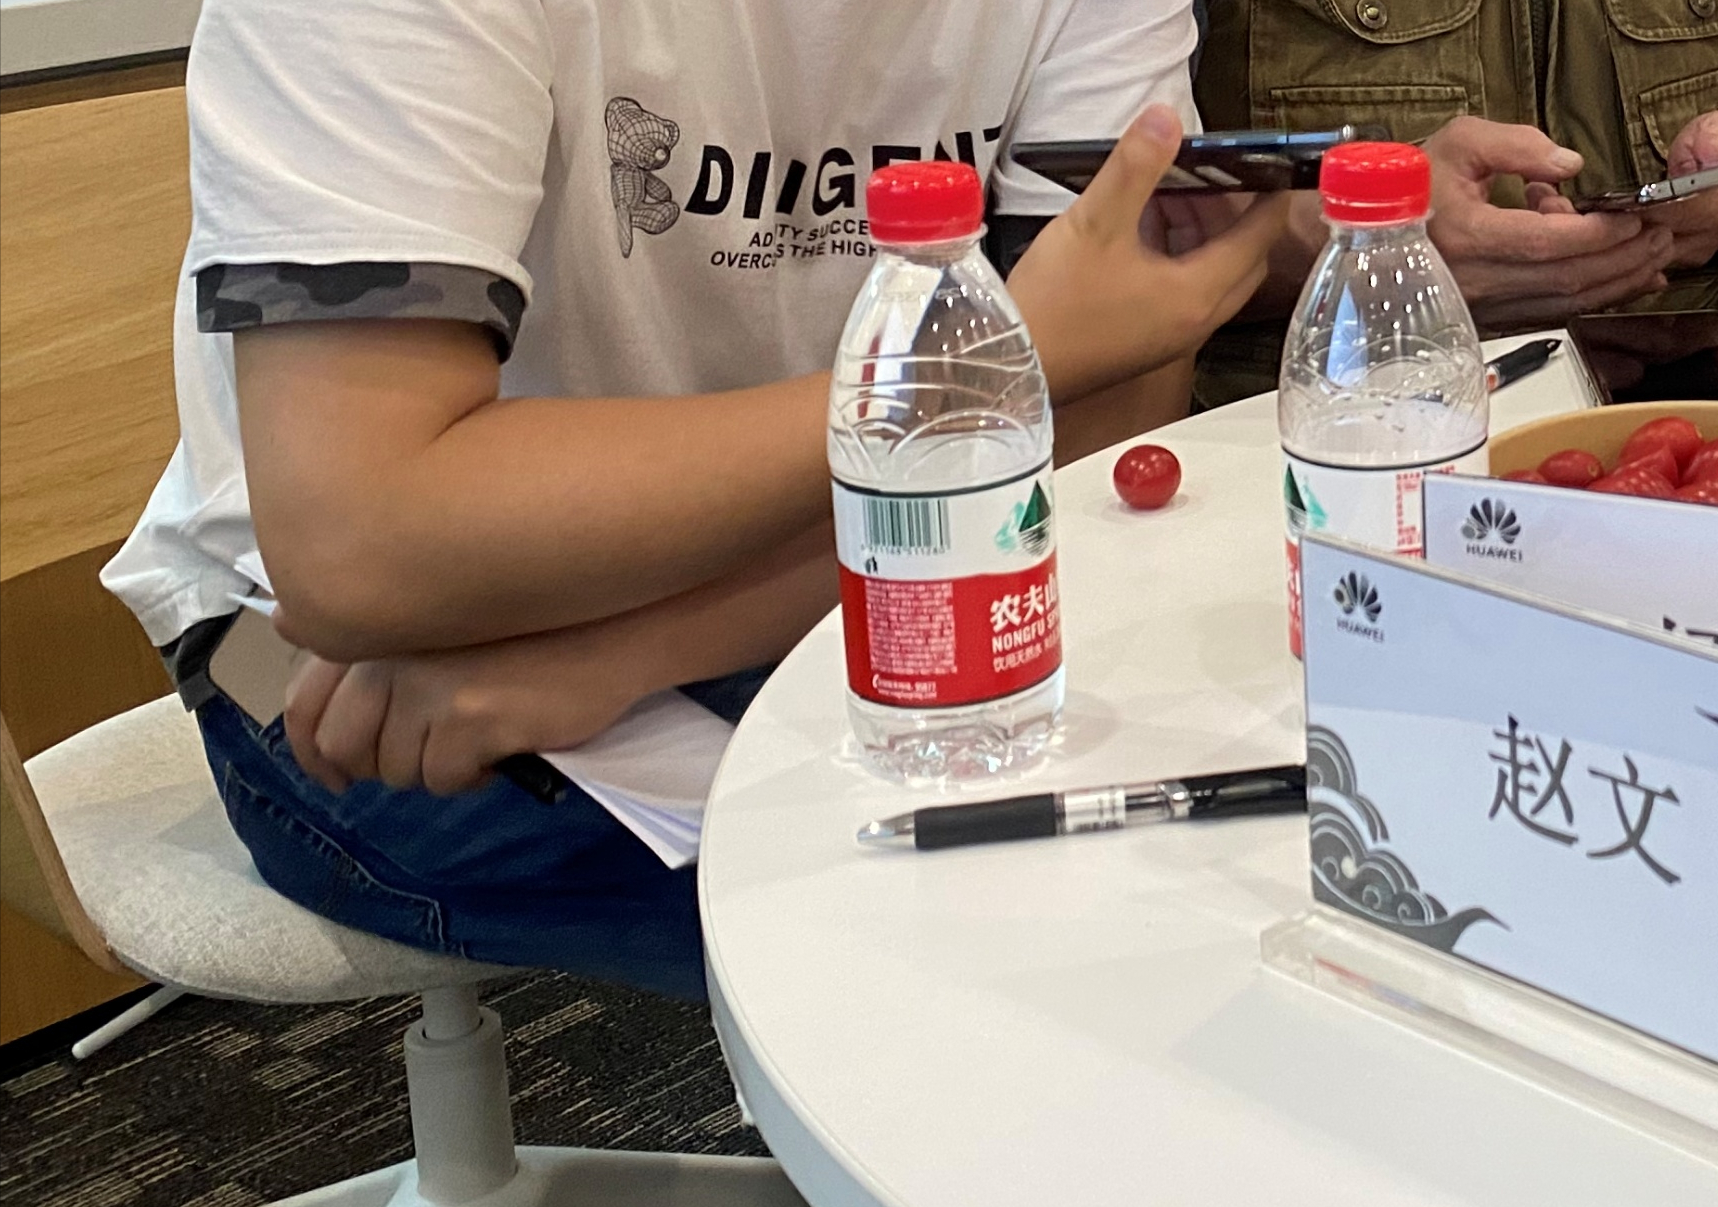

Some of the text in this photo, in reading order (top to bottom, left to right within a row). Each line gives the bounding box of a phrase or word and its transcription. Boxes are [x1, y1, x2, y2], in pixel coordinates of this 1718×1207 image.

[1466, 544, 1523, 561] HUAWEI
[992, 617, 1045, 654] NONGFU
[1336, 618, 1385, 643] HUAWEI
[1488, 711, 1682, 885] 赵文
